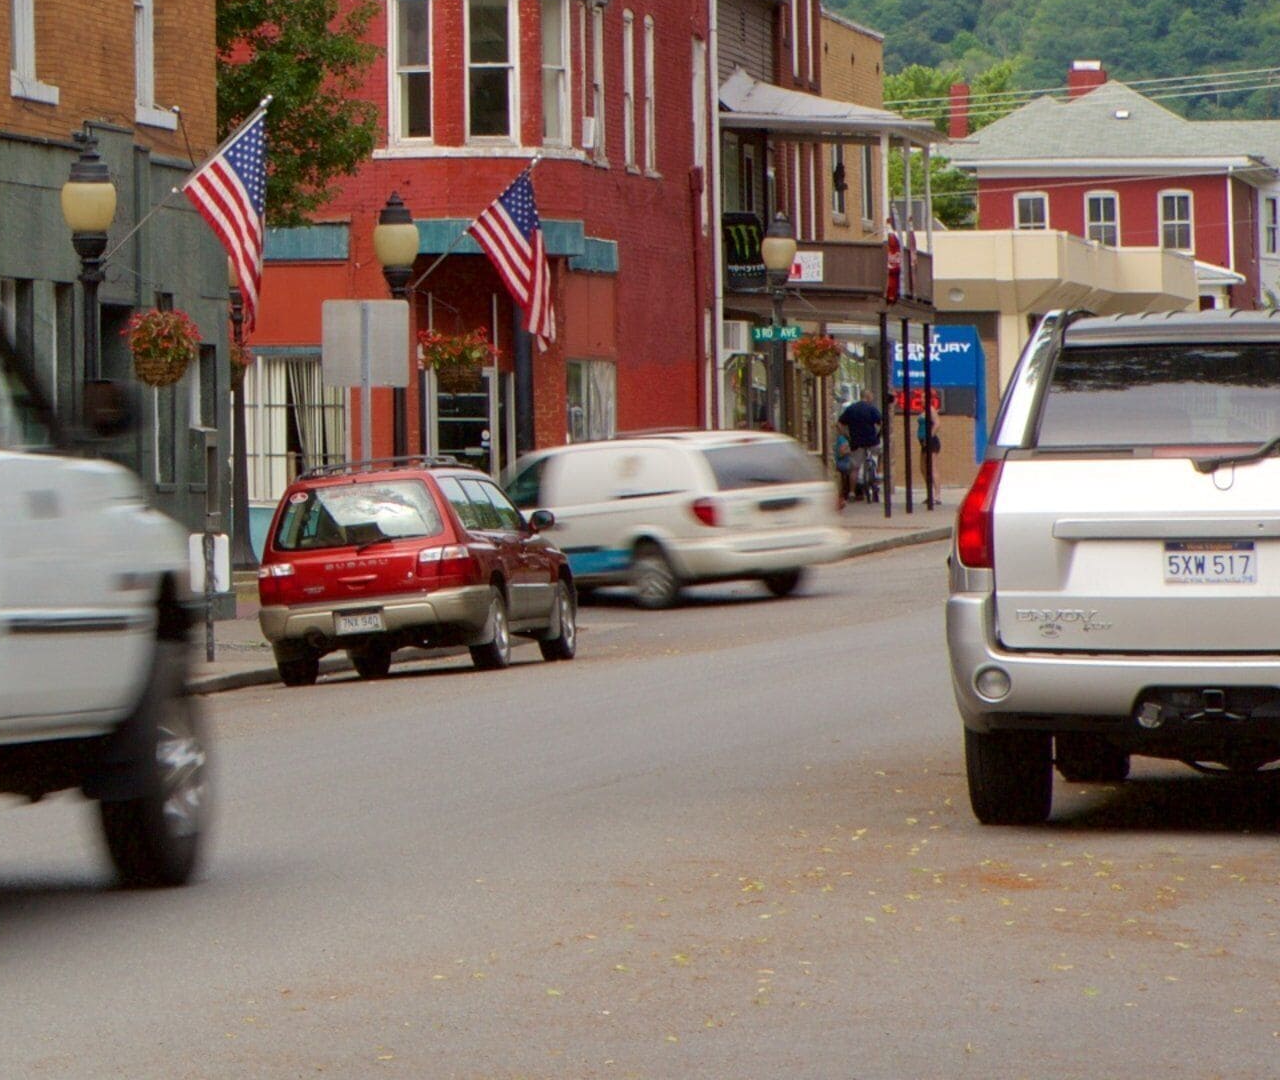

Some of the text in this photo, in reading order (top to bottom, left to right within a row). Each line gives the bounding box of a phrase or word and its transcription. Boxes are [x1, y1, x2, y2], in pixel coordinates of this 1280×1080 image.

[755, 327, 797, 338] 3RD AVE
[895, 342, 971, 353] CENTURY
[324, 558, 389, 571] SUBARU
[1168, 554, 1250, 575] 5XW 517
